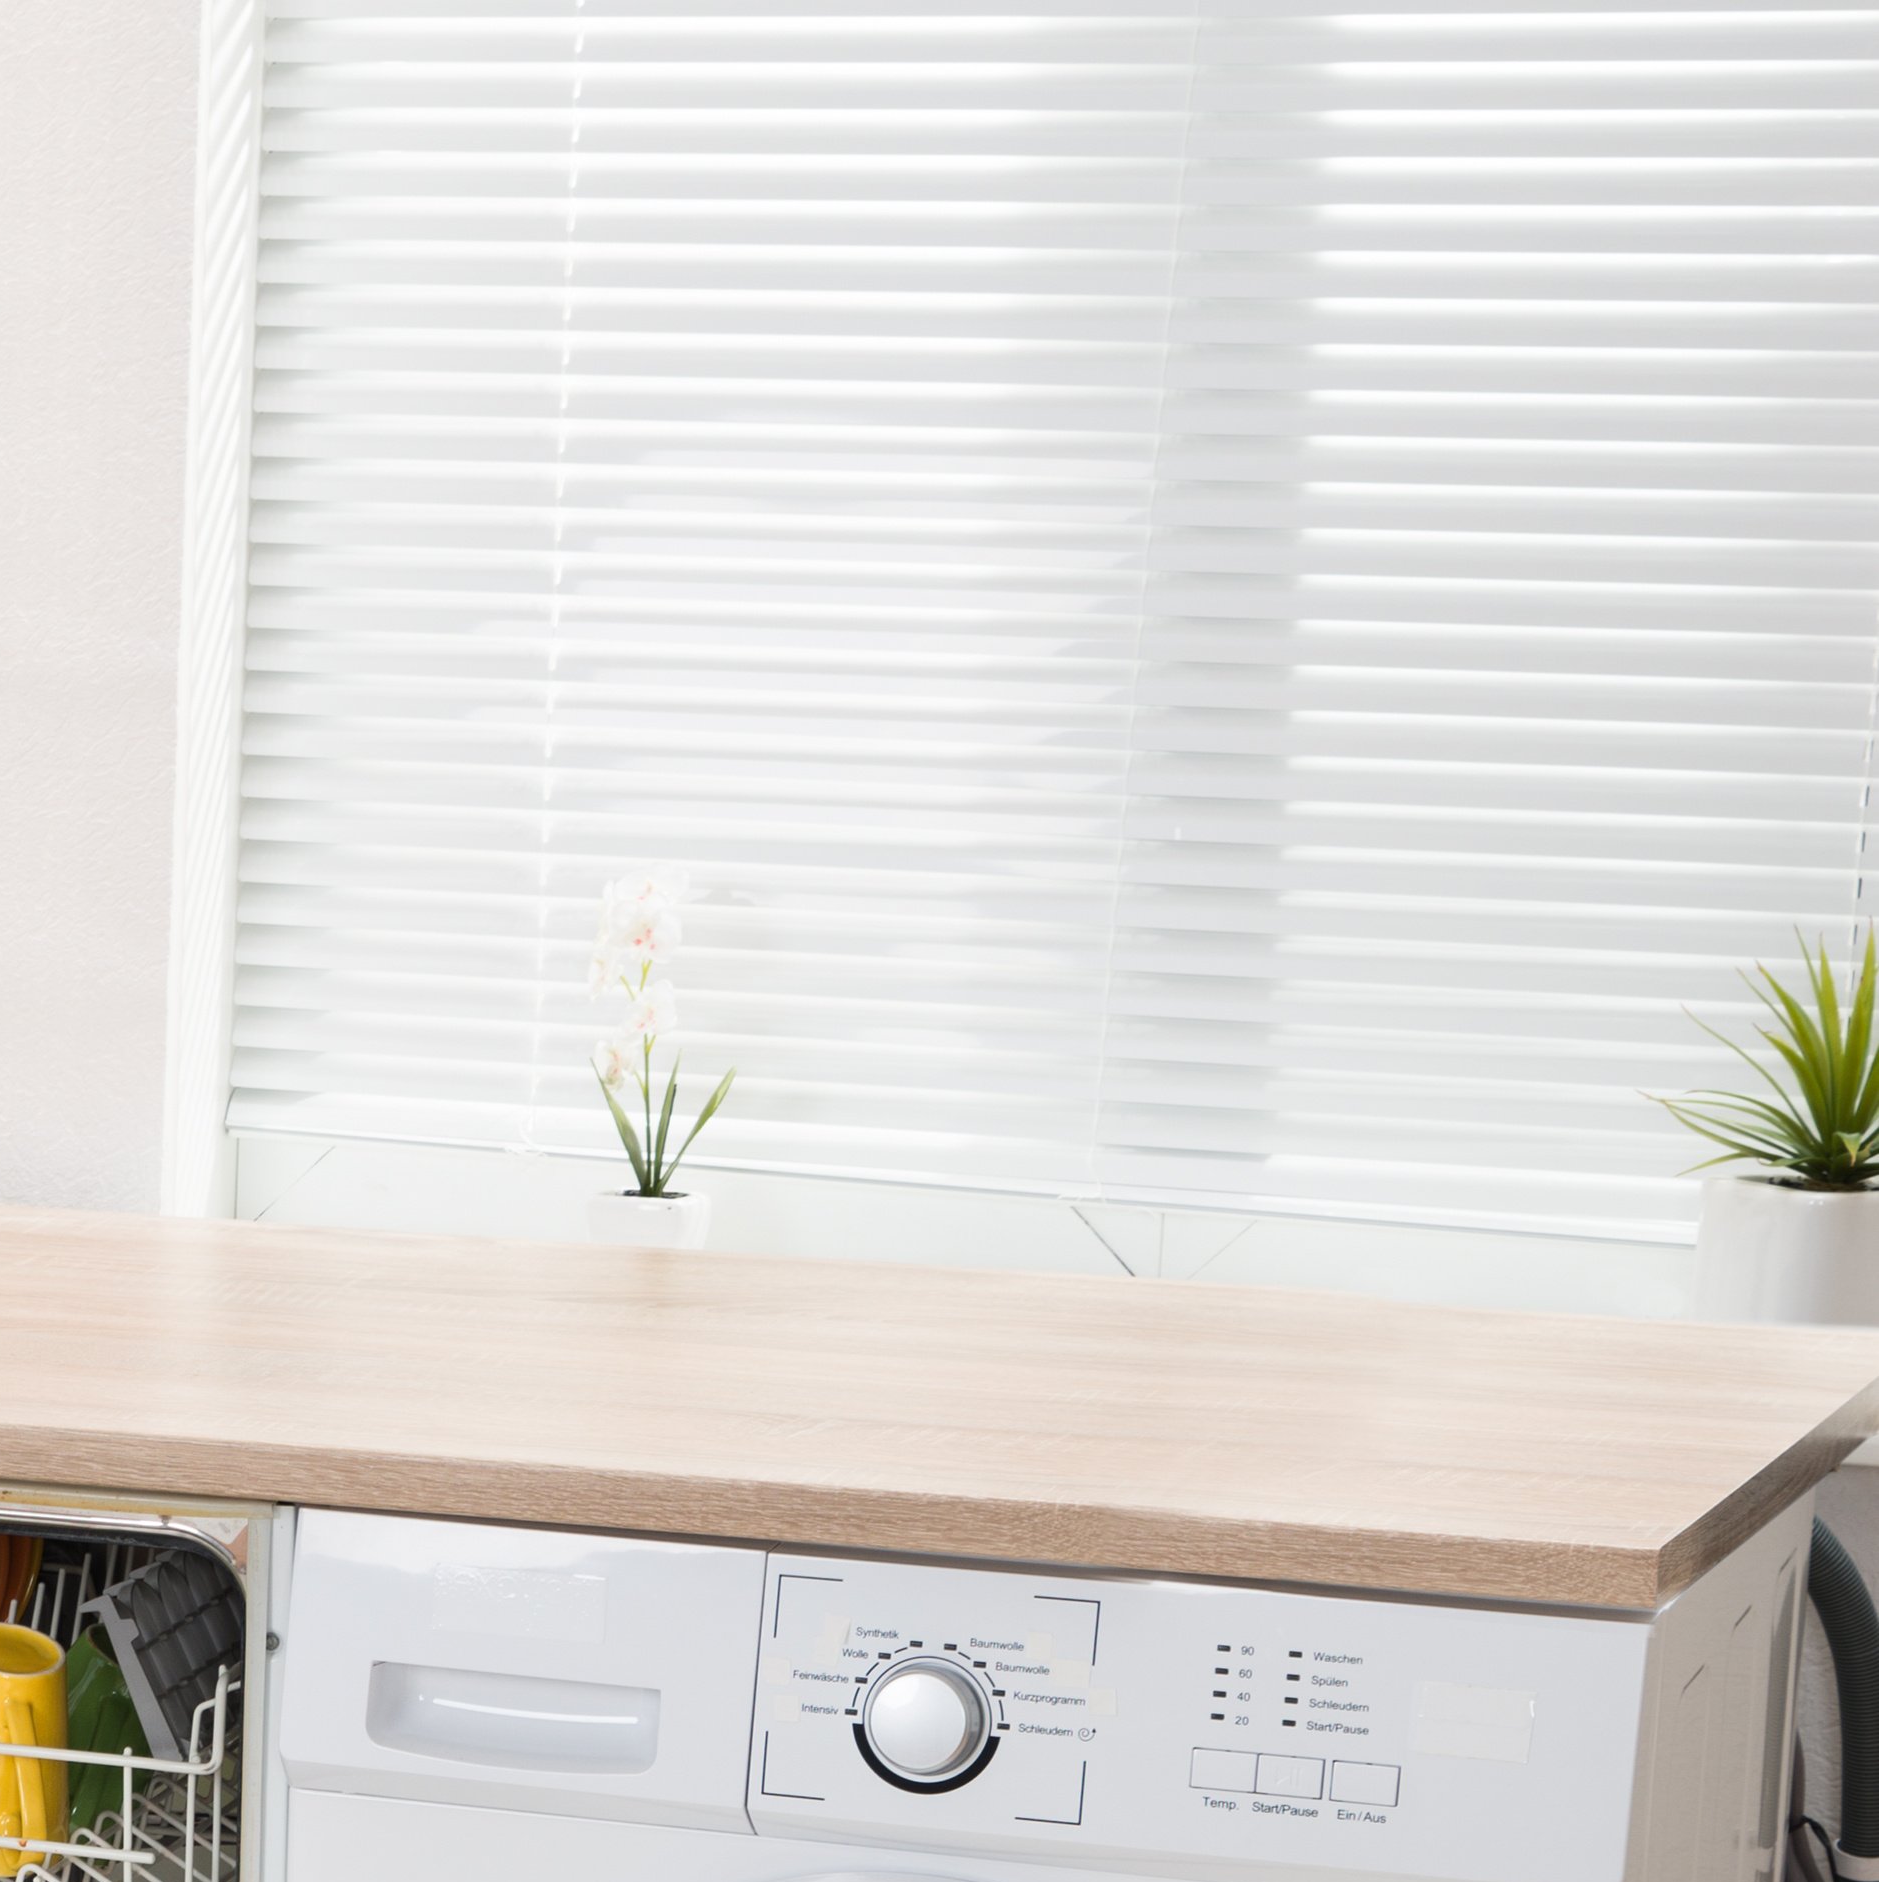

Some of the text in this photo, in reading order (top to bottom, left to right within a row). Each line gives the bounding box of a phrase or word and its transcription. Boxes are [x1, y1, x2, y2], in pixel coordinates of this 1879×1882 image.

[856, 1626, 899, 1640] Synthetik
[969, 1637, 1025, 1652] Baumwolle
[1241, 1645, 1255, 1656] 90
[842, 1647, 869, 1660] Wolle
[1313, 1651, 1364, 1665] Waschen
[995, 1660, 1050, 1676] Baumwolle
[1239, 1668, 1253, 1679] 60
[793, 1668, 849, 1684] Feinwäsche
[1311, 1675, 1349, 1688] Spülen
[1013, 1690, 1086, 1706] Kurzprogramm
[1237, 1691, 1251, 1702] 40
[801, 1702, 839, 1715] Intensiv
[1309, 1698, 1370, 1712] Schleudern
[1234, 1715, 1250, 1726] 20
[1306, 1720, 1370, 1736] Start/Pause
[1202, 1796, 1240, 1811] Temp.
[1252, 1801, 1319, 1818] Start/Pause
